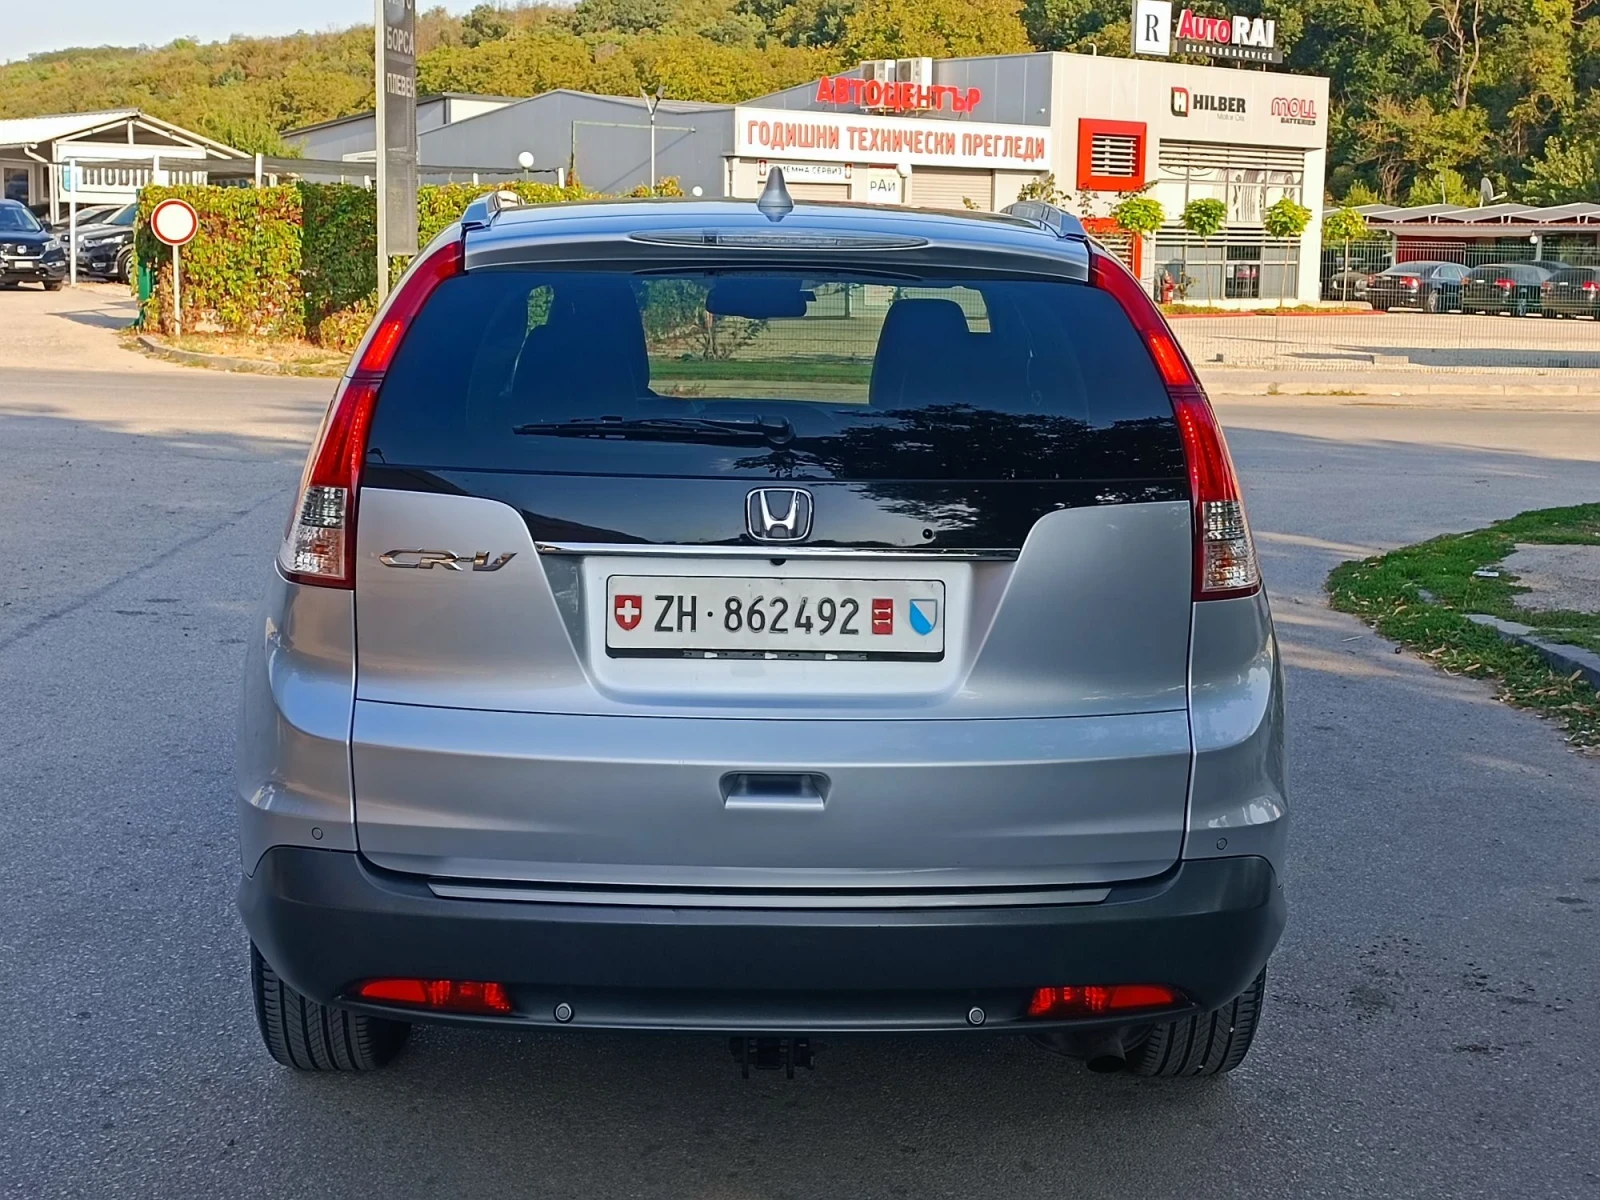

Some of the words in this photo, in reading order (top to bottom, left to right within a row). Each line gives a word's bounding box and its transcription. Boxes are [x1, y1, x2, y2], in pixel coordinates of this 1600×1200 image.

[386, 26, 414, 55] БОРСА
[1145, 14, 1159, 42] R
[1231, 16, 1275, 48] RAI
[1232, 49, 1273, 61] SERVICE
[815, 75, 982, 112] АВТОЦЕНТЪР
[1193, 94, 1246, 113] HILBER
[1281, 117, 1316, 126] BATTERIES
[748, 120, 839, 150] ГОДИШНИ
[846, 126, 955, 155] ТЕХНИЧЕСКИ
[962, 133, 1045, 160] ПРЕГЛЕДИ
[769, 164, 810, 173] ИЕМНА
[379, 547, 518, 572] CR-V
[724, 595, 860, 636] 862492
